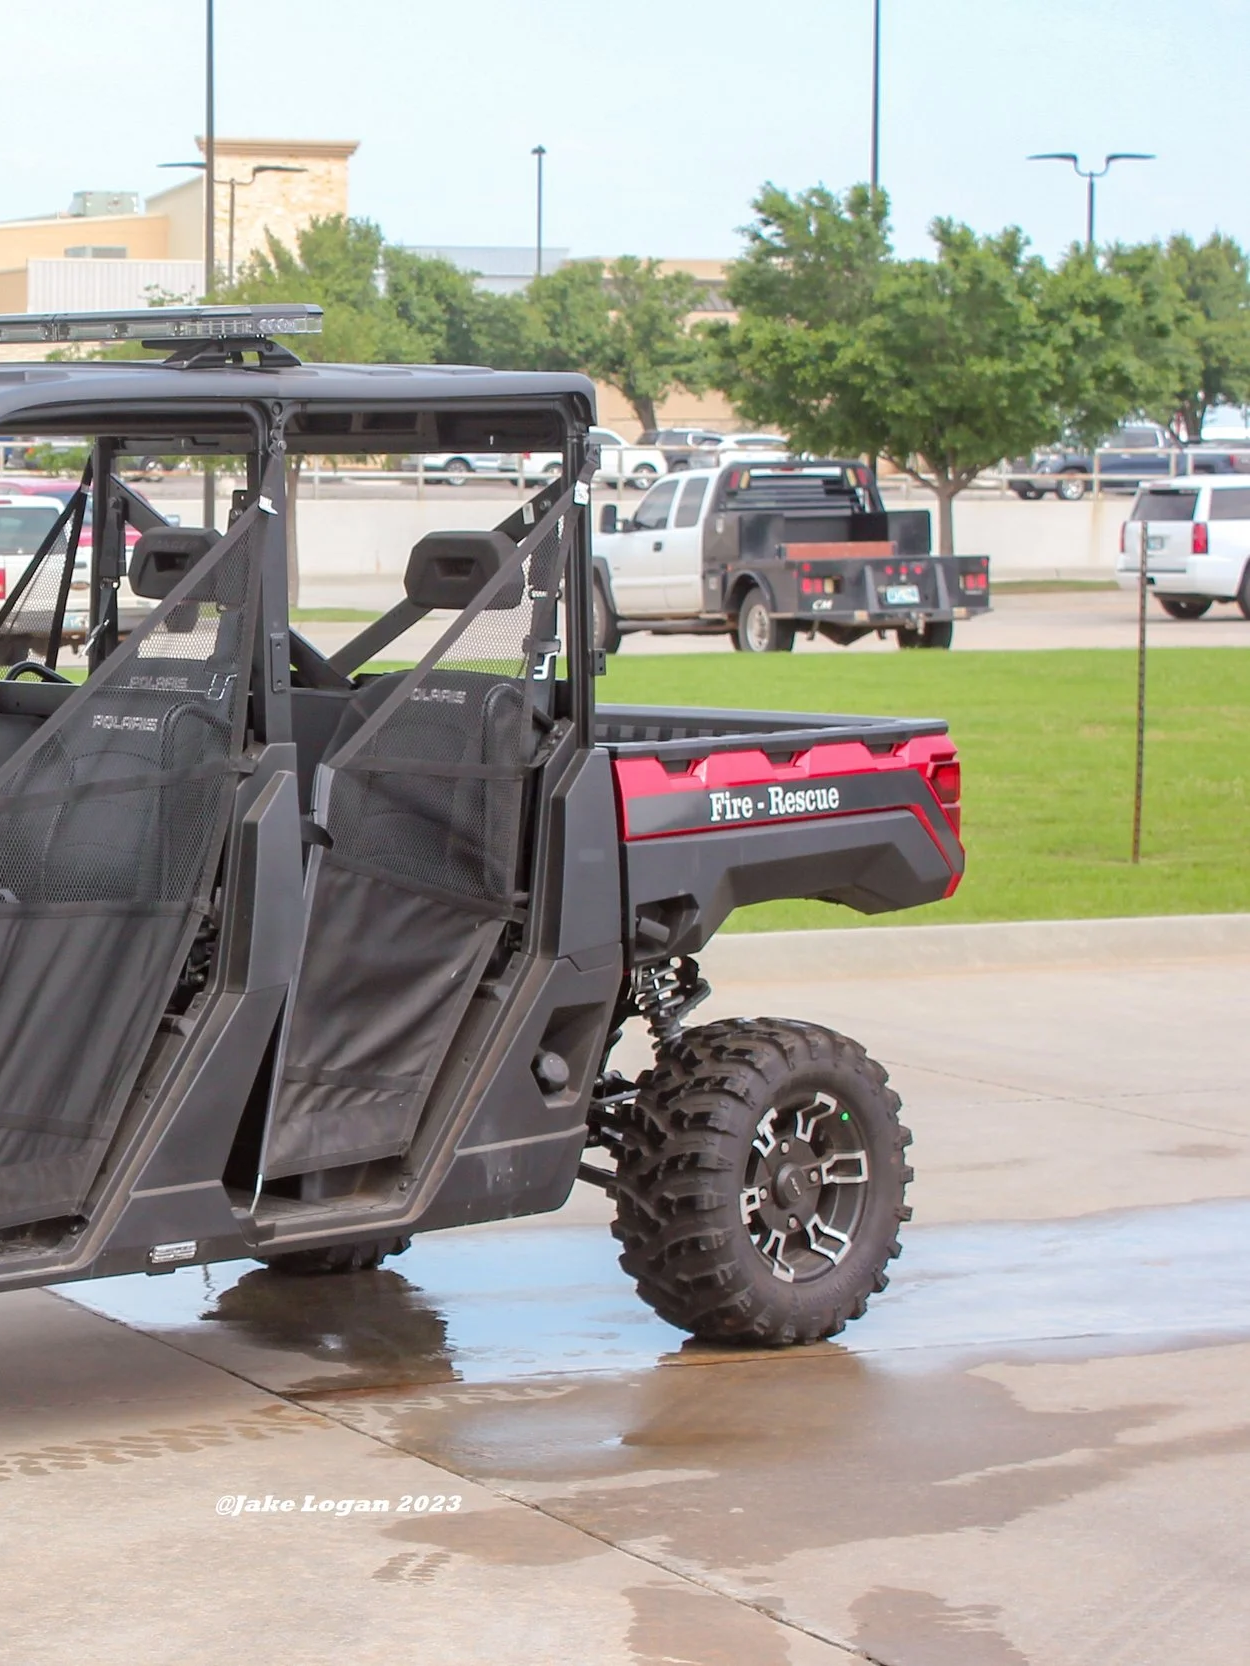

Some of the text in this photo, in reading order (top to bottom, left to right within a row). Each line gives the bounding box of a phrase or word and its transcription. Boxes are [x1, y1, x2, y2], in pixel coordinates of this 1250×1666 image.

[812, 599, 833, 611] CM
[130, 675, 188, 690] POLARIS
[411, 687, 467, 704] OLARIS
[92, 714, 158, 732] POLARIS
[709, 791, 753, 822] Fire
[768, 786, 840, 815] Rescue
